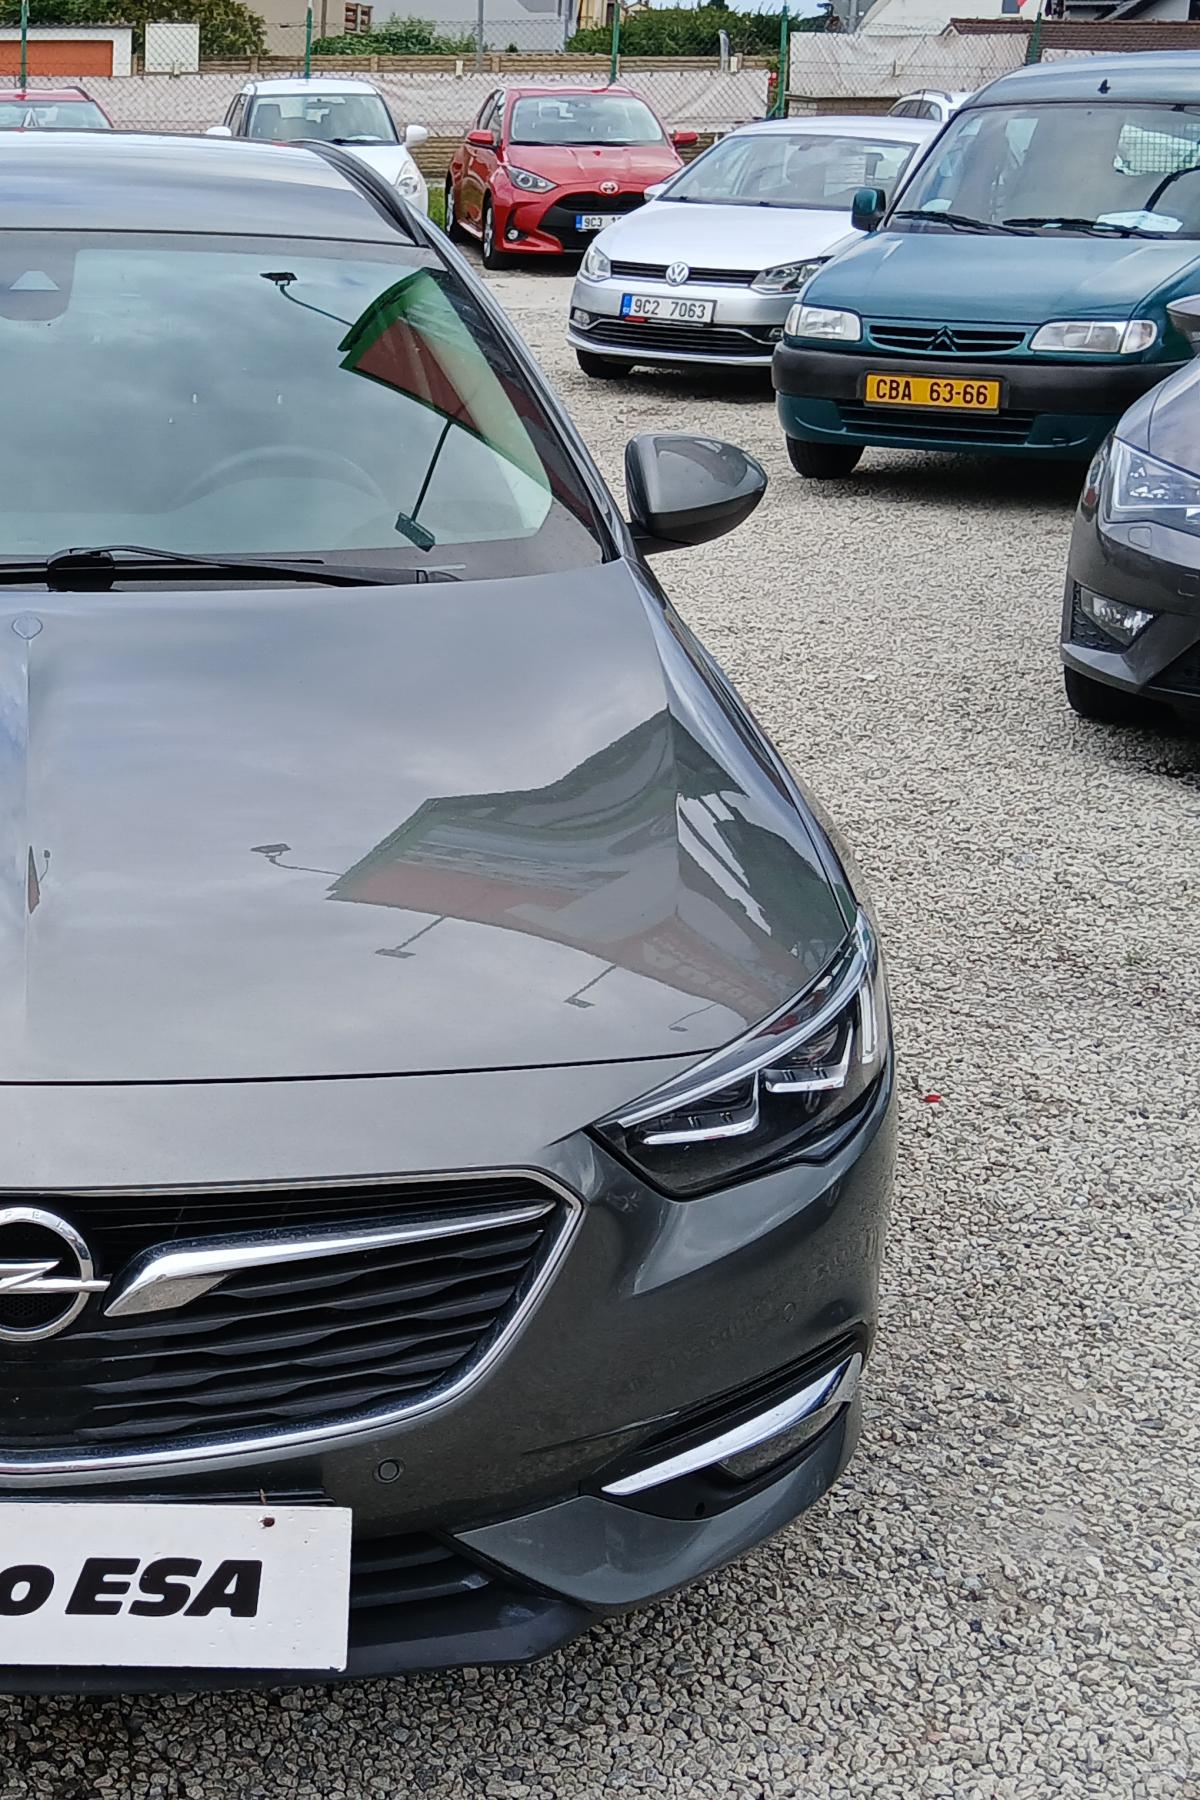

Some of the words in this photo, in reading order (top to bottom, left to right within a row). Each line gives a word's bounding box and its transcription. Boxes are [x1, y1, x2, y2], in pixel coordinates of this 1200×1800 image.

[634, 299, 660, 315] 9C2
[670, 301, 706, 319] 7063
[876, 379, 912, 400] CBA
[930, 382, 988, 404] 63-66
[65, 1557, 263, 1617] ESA
